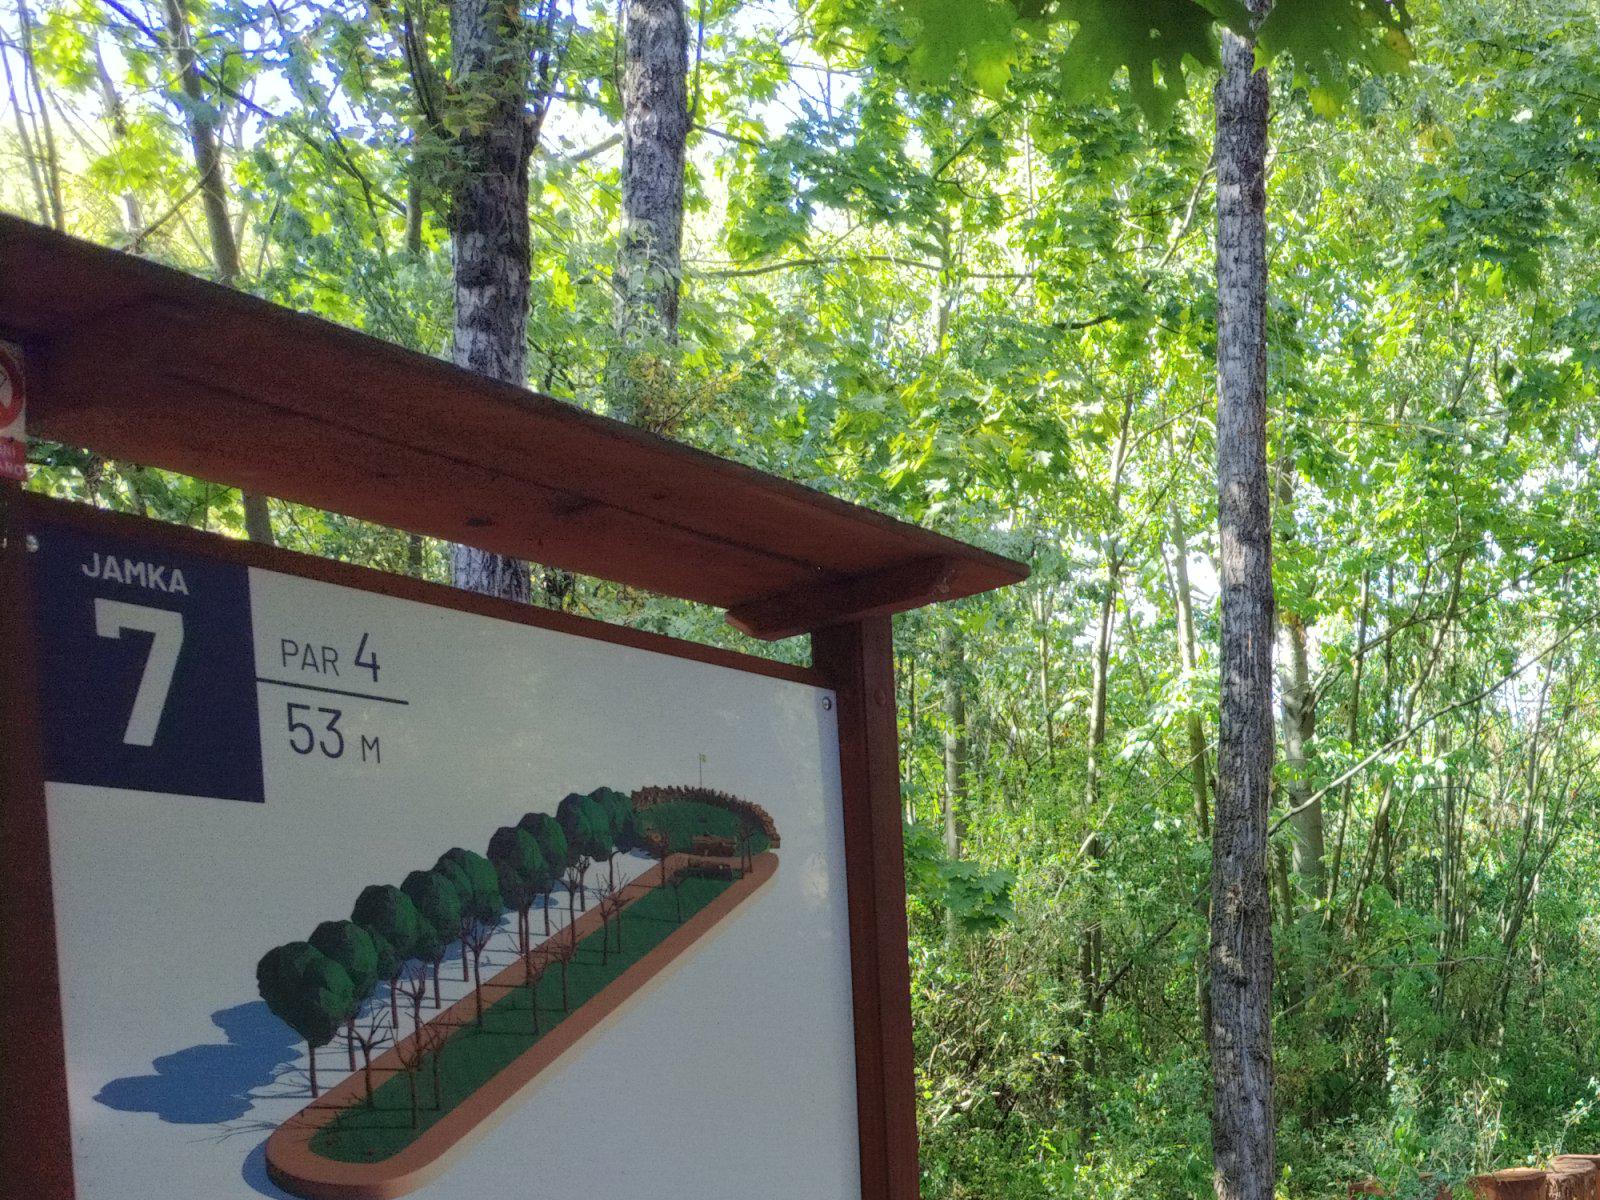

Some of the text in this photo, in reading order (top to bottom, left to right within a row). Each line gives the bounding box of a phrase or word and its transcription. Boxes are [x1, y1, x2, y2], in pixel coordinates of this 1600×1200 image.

[81, 552, 189, 596] JAMKA
[94, 597, 184, 747] 7
[281, 632, 381, 683] PAR 4
[287, 702, 381, 764] 53 M
